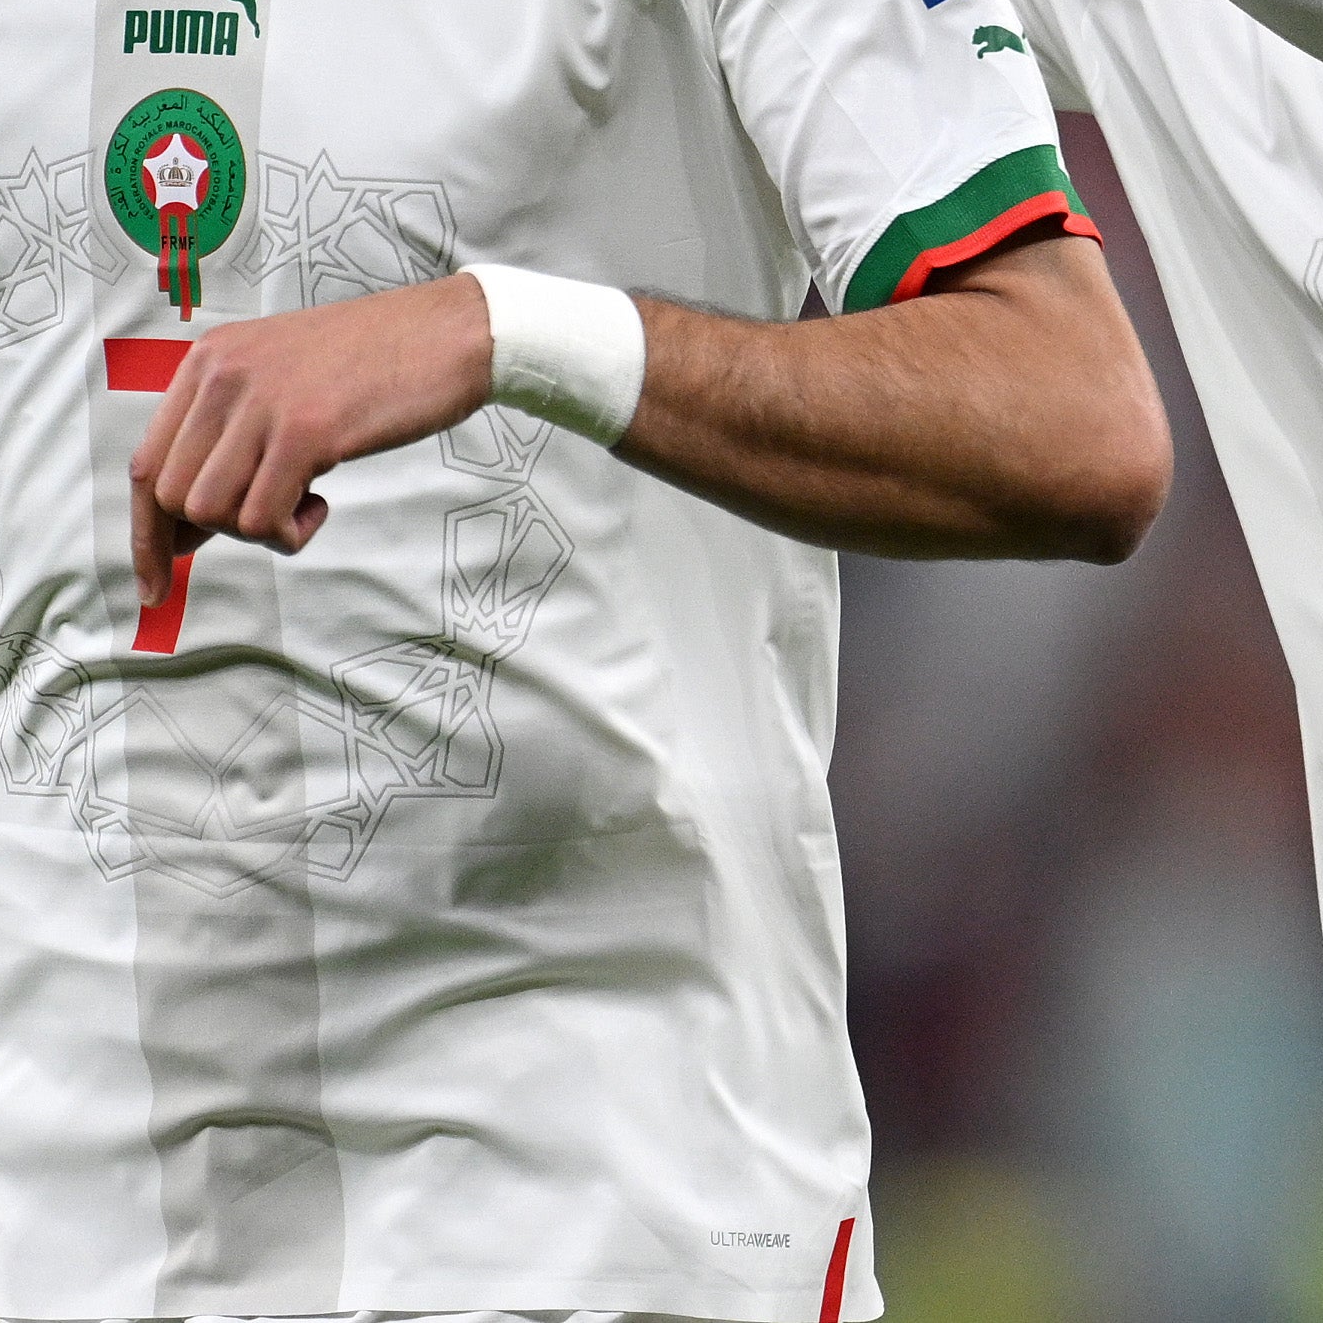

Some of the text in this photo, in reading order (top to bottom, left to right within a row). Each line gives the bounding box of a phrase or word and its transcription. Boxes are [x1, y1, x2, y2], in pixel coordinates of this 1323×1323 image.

[123, 9, 239, 56] PUMA
[134, 122, 164, 156] ROYALE
[165, 121, 213, 150] MAROCAINE
[209, 152, 219, 168] DE
[161, 236, 194, 250] FRMF
[710, 1230, 791, 1249] ULTRAWEAVE
